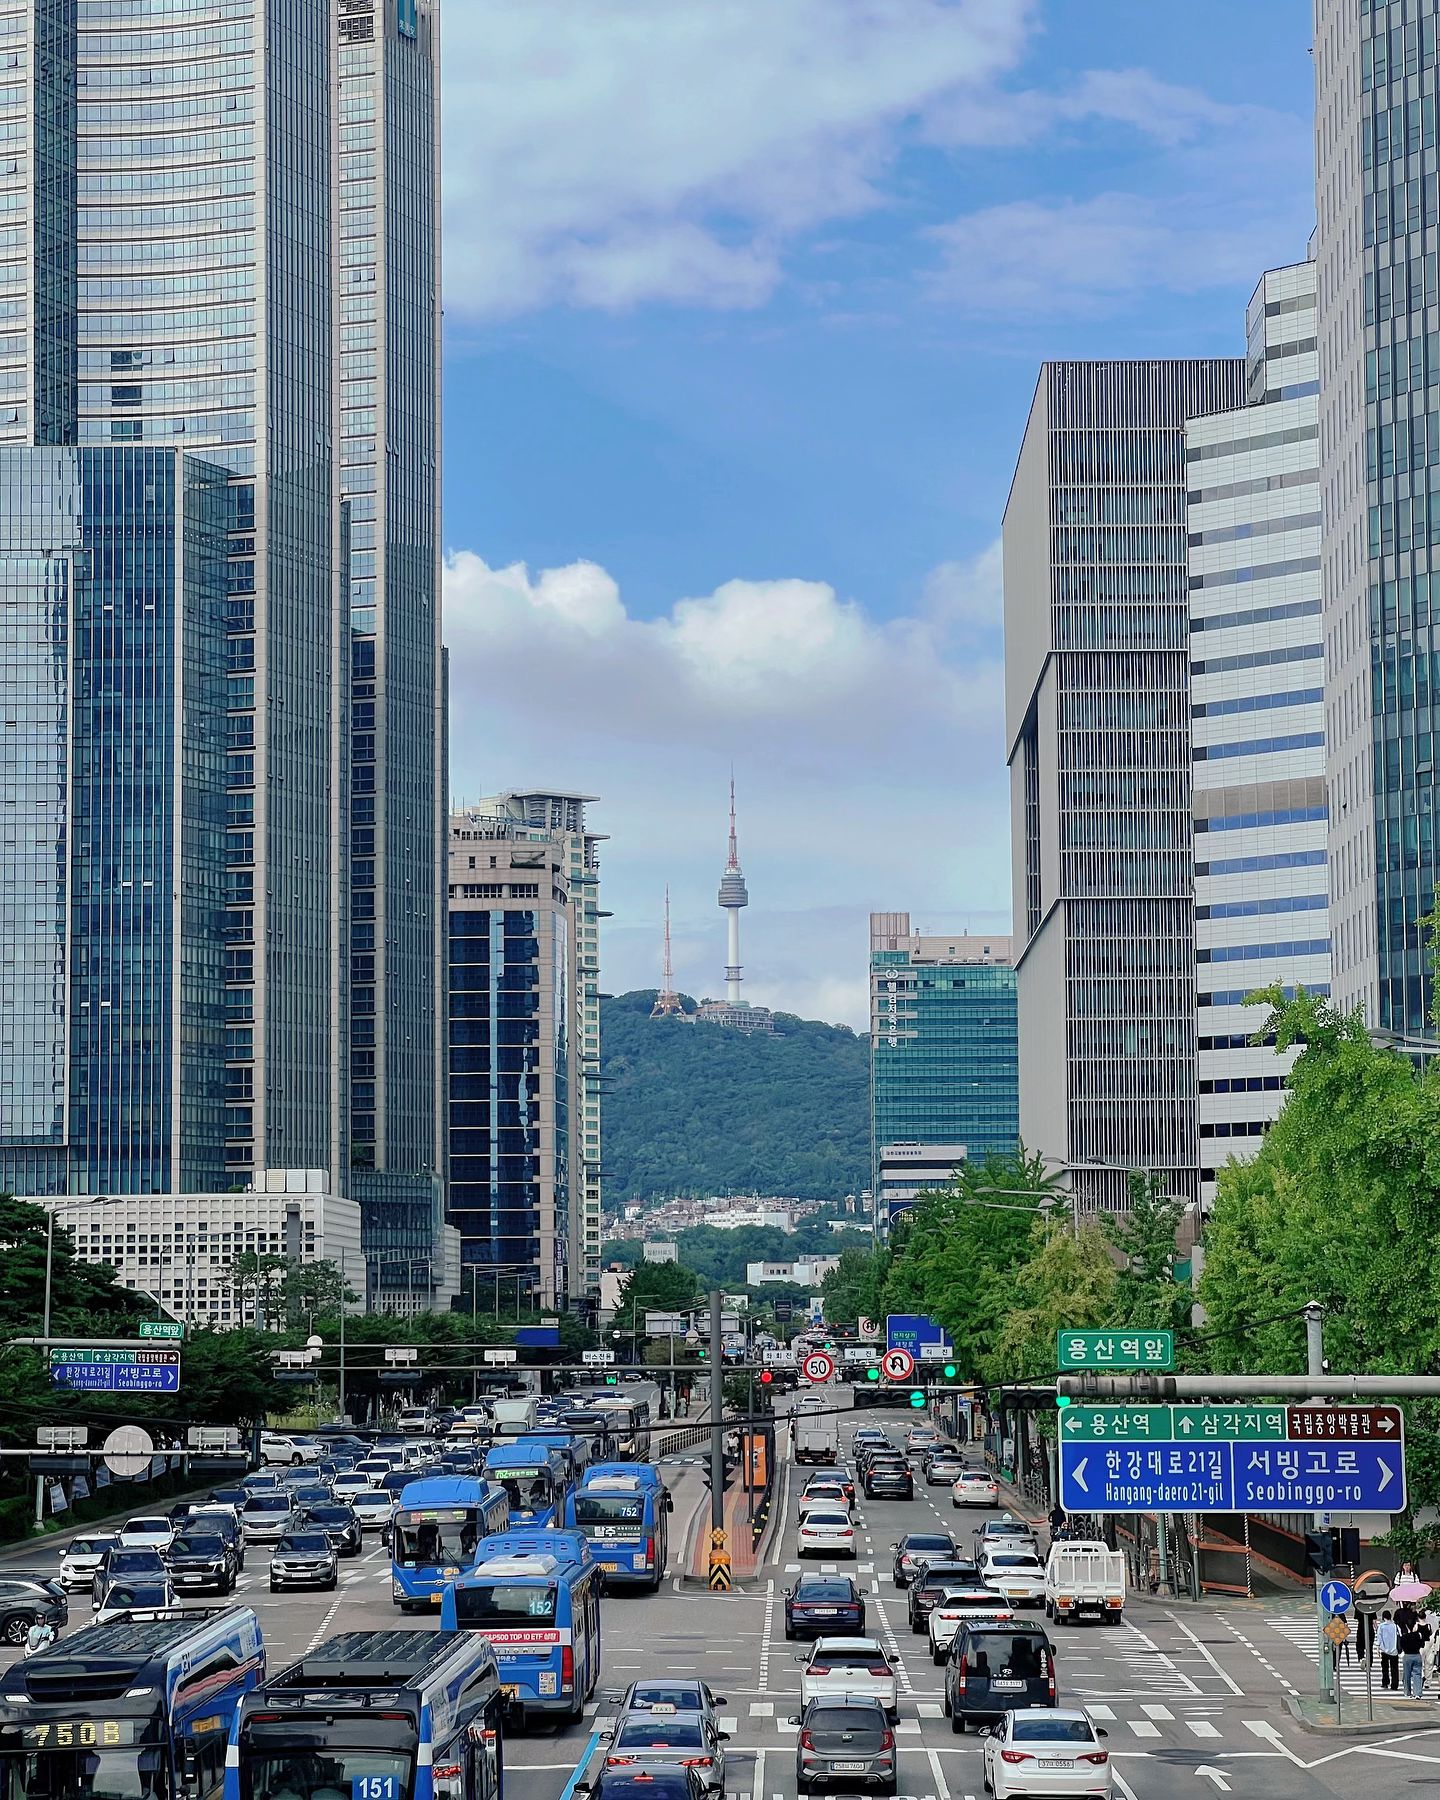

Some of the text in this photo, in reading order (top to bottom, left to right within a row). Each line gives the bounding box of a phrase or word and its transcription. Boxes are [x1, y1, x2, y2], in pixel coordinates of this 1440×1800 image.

[143, 1325, 180, 1336] 용산역앞
[61, 1352, 84, 1362] 용산역
[103, 1353, 135, 1362] 삼각지역
[584, 1352, 614, 1361] 버스전용
[1067, 1338, 1164, 1361] 용산역앞
[119, 1367, 162, 1379] 서빙고로
[810, 1361, 827, 1375] 50
[118, 1379, 163, 1389] Seobinggo-ro
[1089, 1413, 1150, 1436] 용산역
[1201, 1413, 1283, 1436] 삼각지역
[1292, 1413, 1372, 1437] 국립중앙박물관
[1105, 1450, 1223, 1481] 한강대로21길
[1247, 1450, 1361, 1480] 서빙고로
[1105, 1482, 1224, 1504] Hangang-daero 21-gil
[1247, 1481, 1362, 1505] Seobinggo-ro
[621, 1507, 637, 1517] 752
[529, 1601, 552, 1614] 152
[34, 1721, 120, 1747] 750B
[359, 1777, 393, 1799] 151
